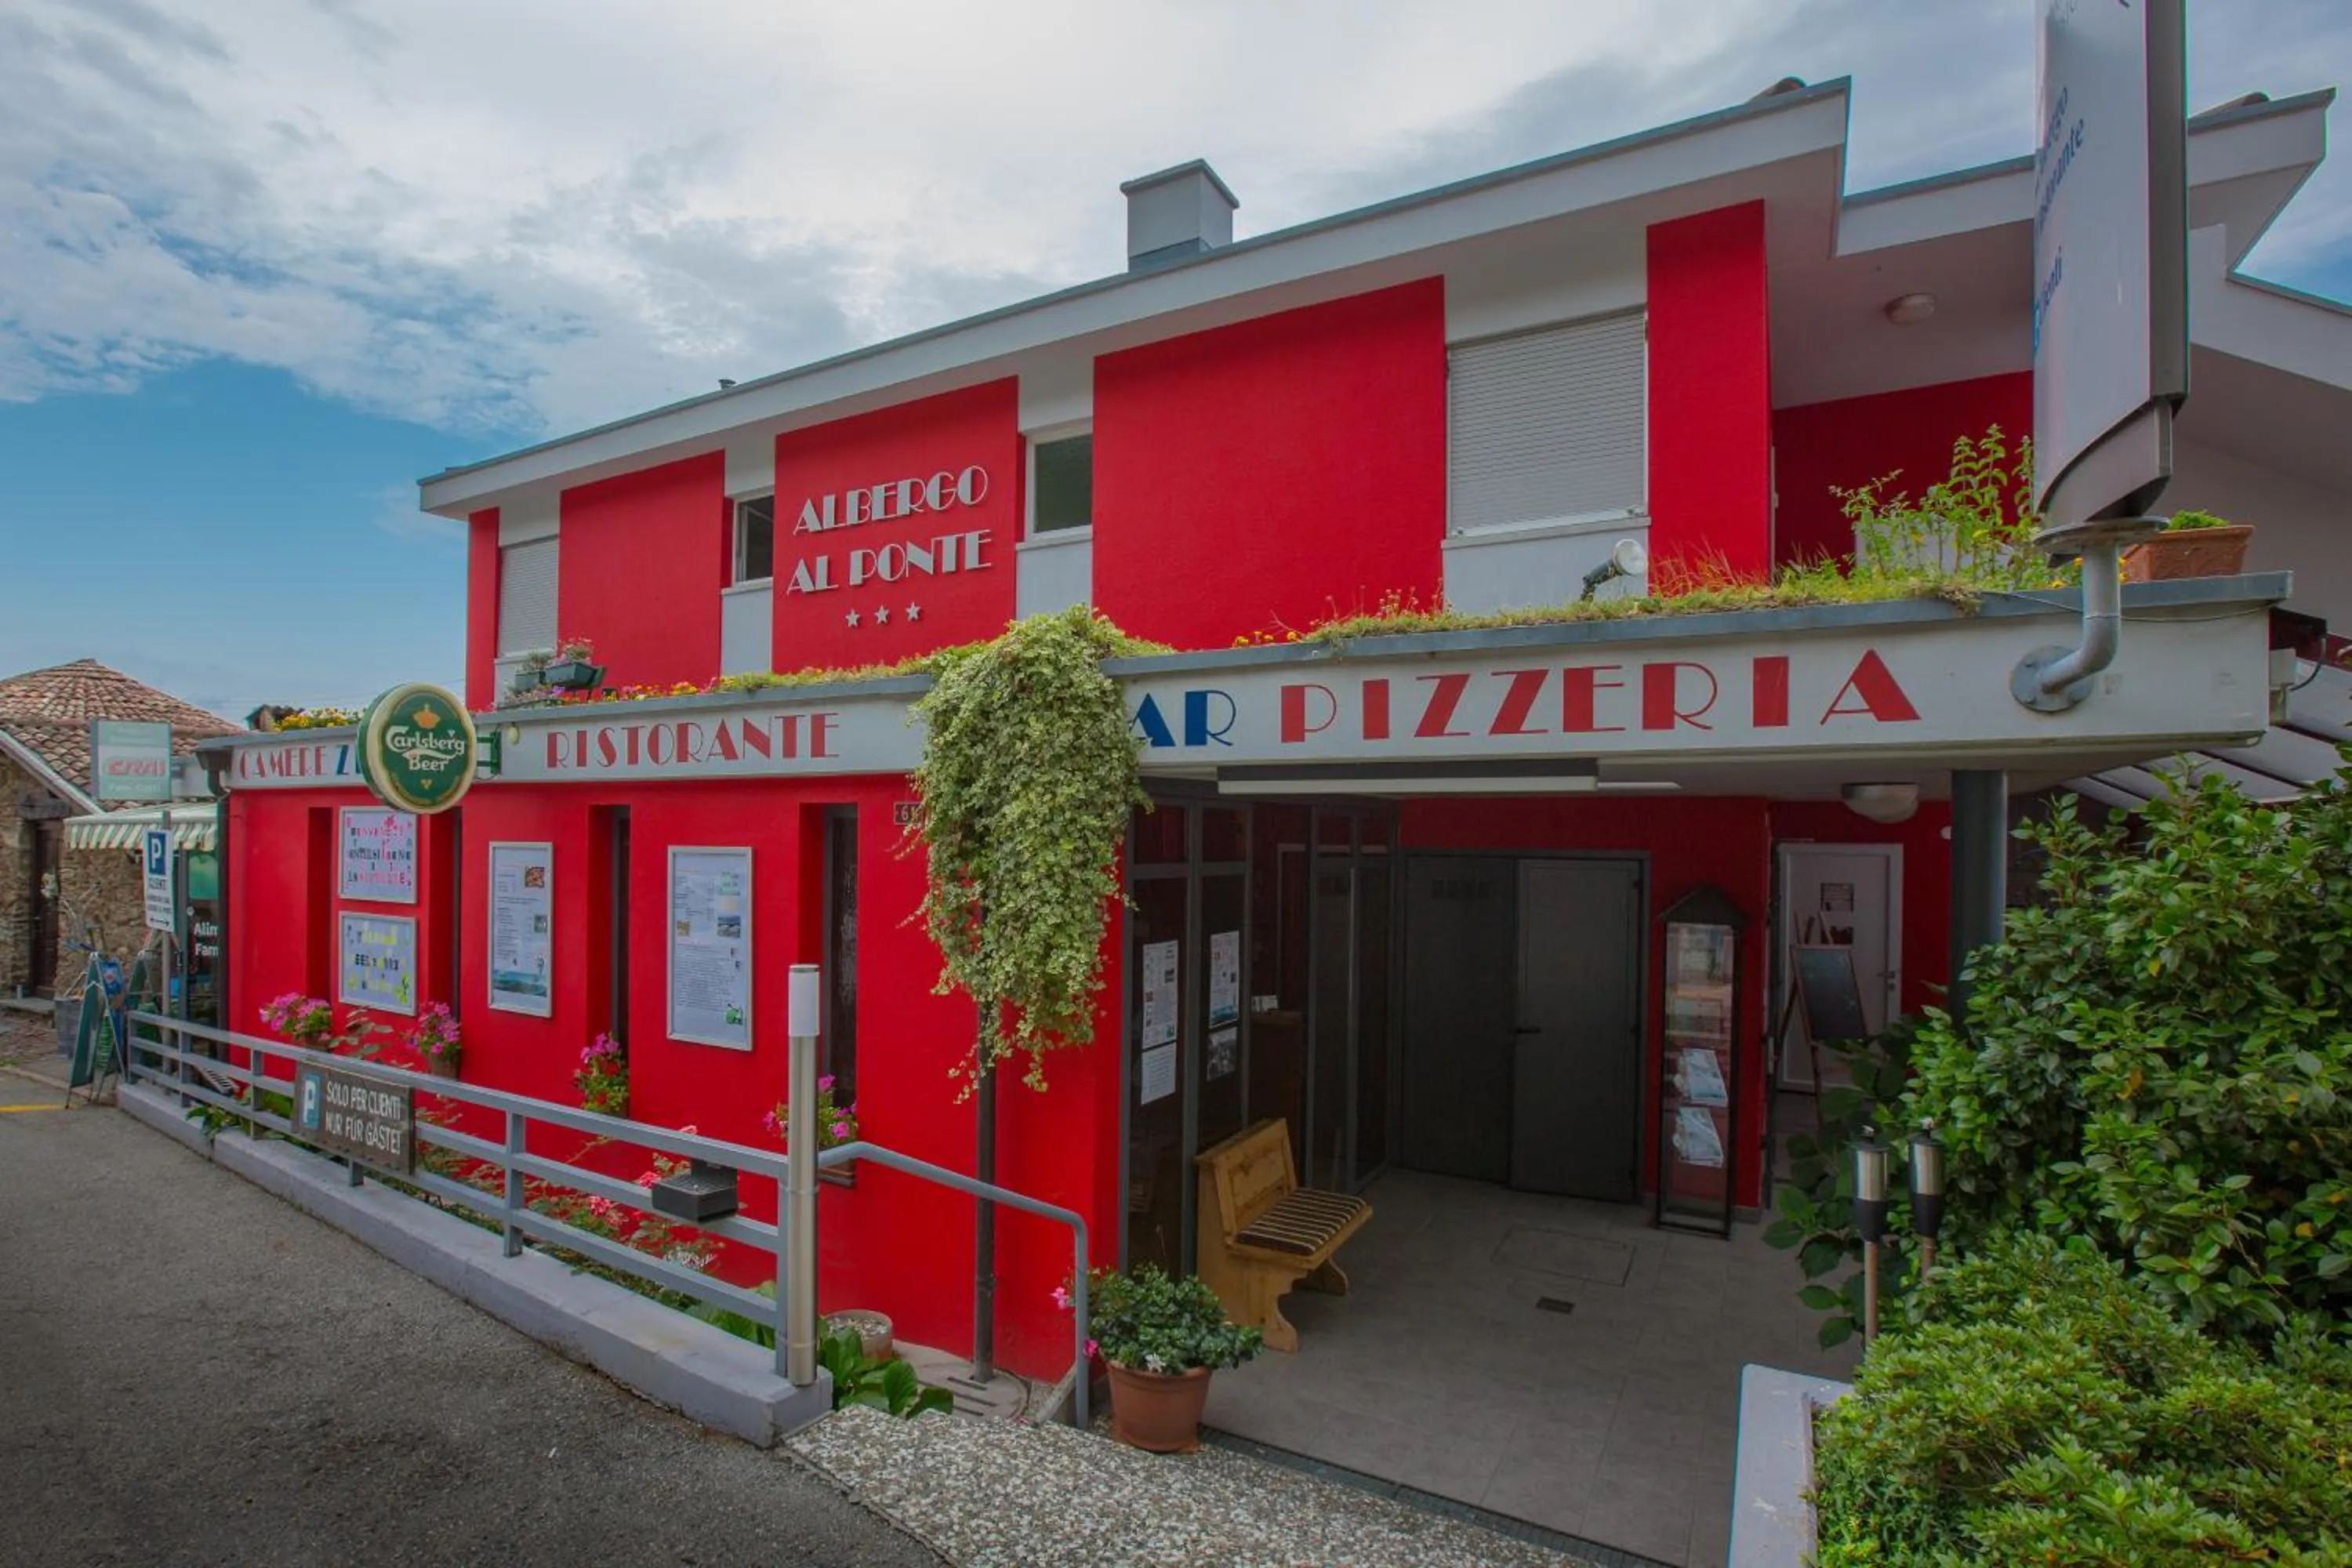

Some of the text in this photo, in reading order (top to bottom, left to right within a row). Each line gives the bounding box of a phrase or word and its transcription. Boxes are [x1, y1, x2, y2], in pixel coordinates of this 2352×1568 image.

[793, 465, 989, 535] ALBERGO
[786, 529, 992, 595] AL PONTE
[1128, 648, 1922, 747] AR PIZZERIA
[386, 725, 465, 758] Carlsberg
[546, 713, 840, 768] RISTORANTE
[239, 746, 328, 781] CAMERE
[408, 754, 448, 772] Beer
[151, 838, 162, 869] P
[303, 1080, 316, 1123] P
[326, 1080, 401, 1120] SOLO PER CLIENTI
[325, 1110, 343, 1135] NUR
